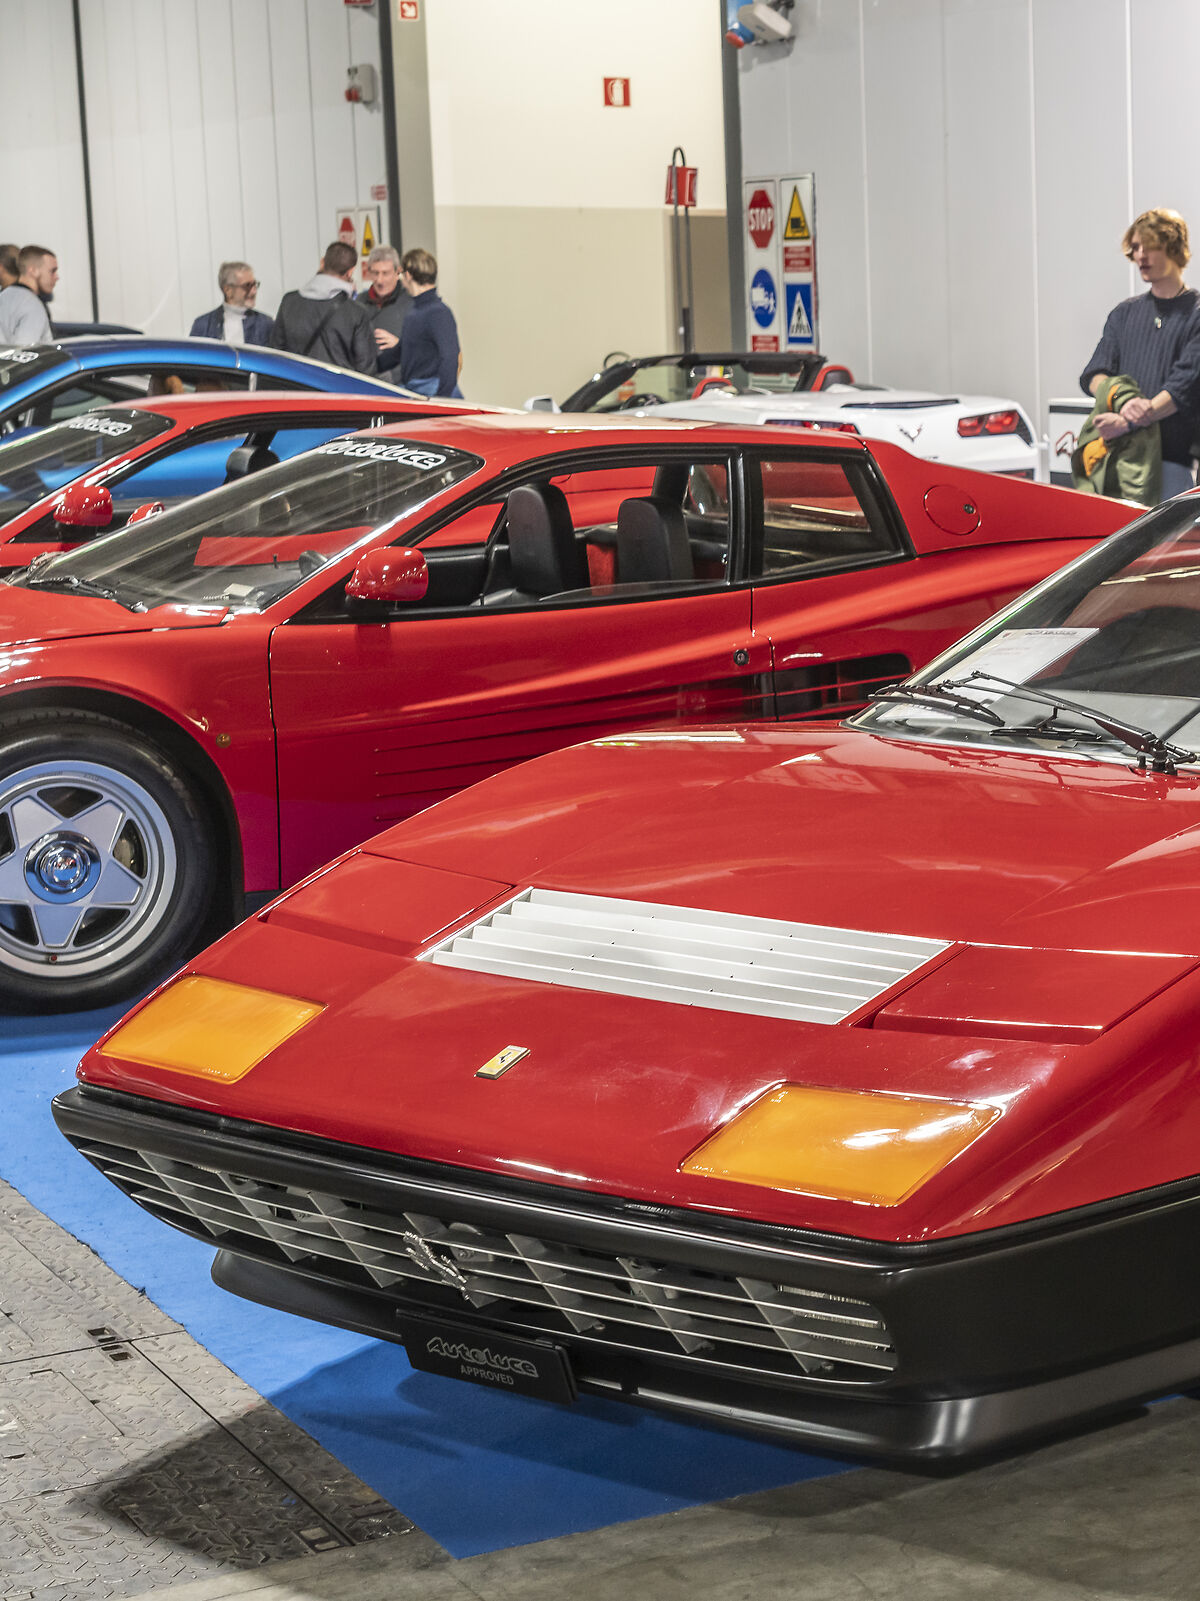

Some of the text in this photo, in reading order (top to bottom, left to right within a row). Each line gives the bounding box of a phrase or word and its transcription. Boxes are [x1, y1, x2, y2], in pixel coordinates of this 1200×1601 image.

[749, 207, 774, 231] STOP
[427, 1336, 539, 1378] Autoluce
[460, 1364, 515, 1386] APPROVED
